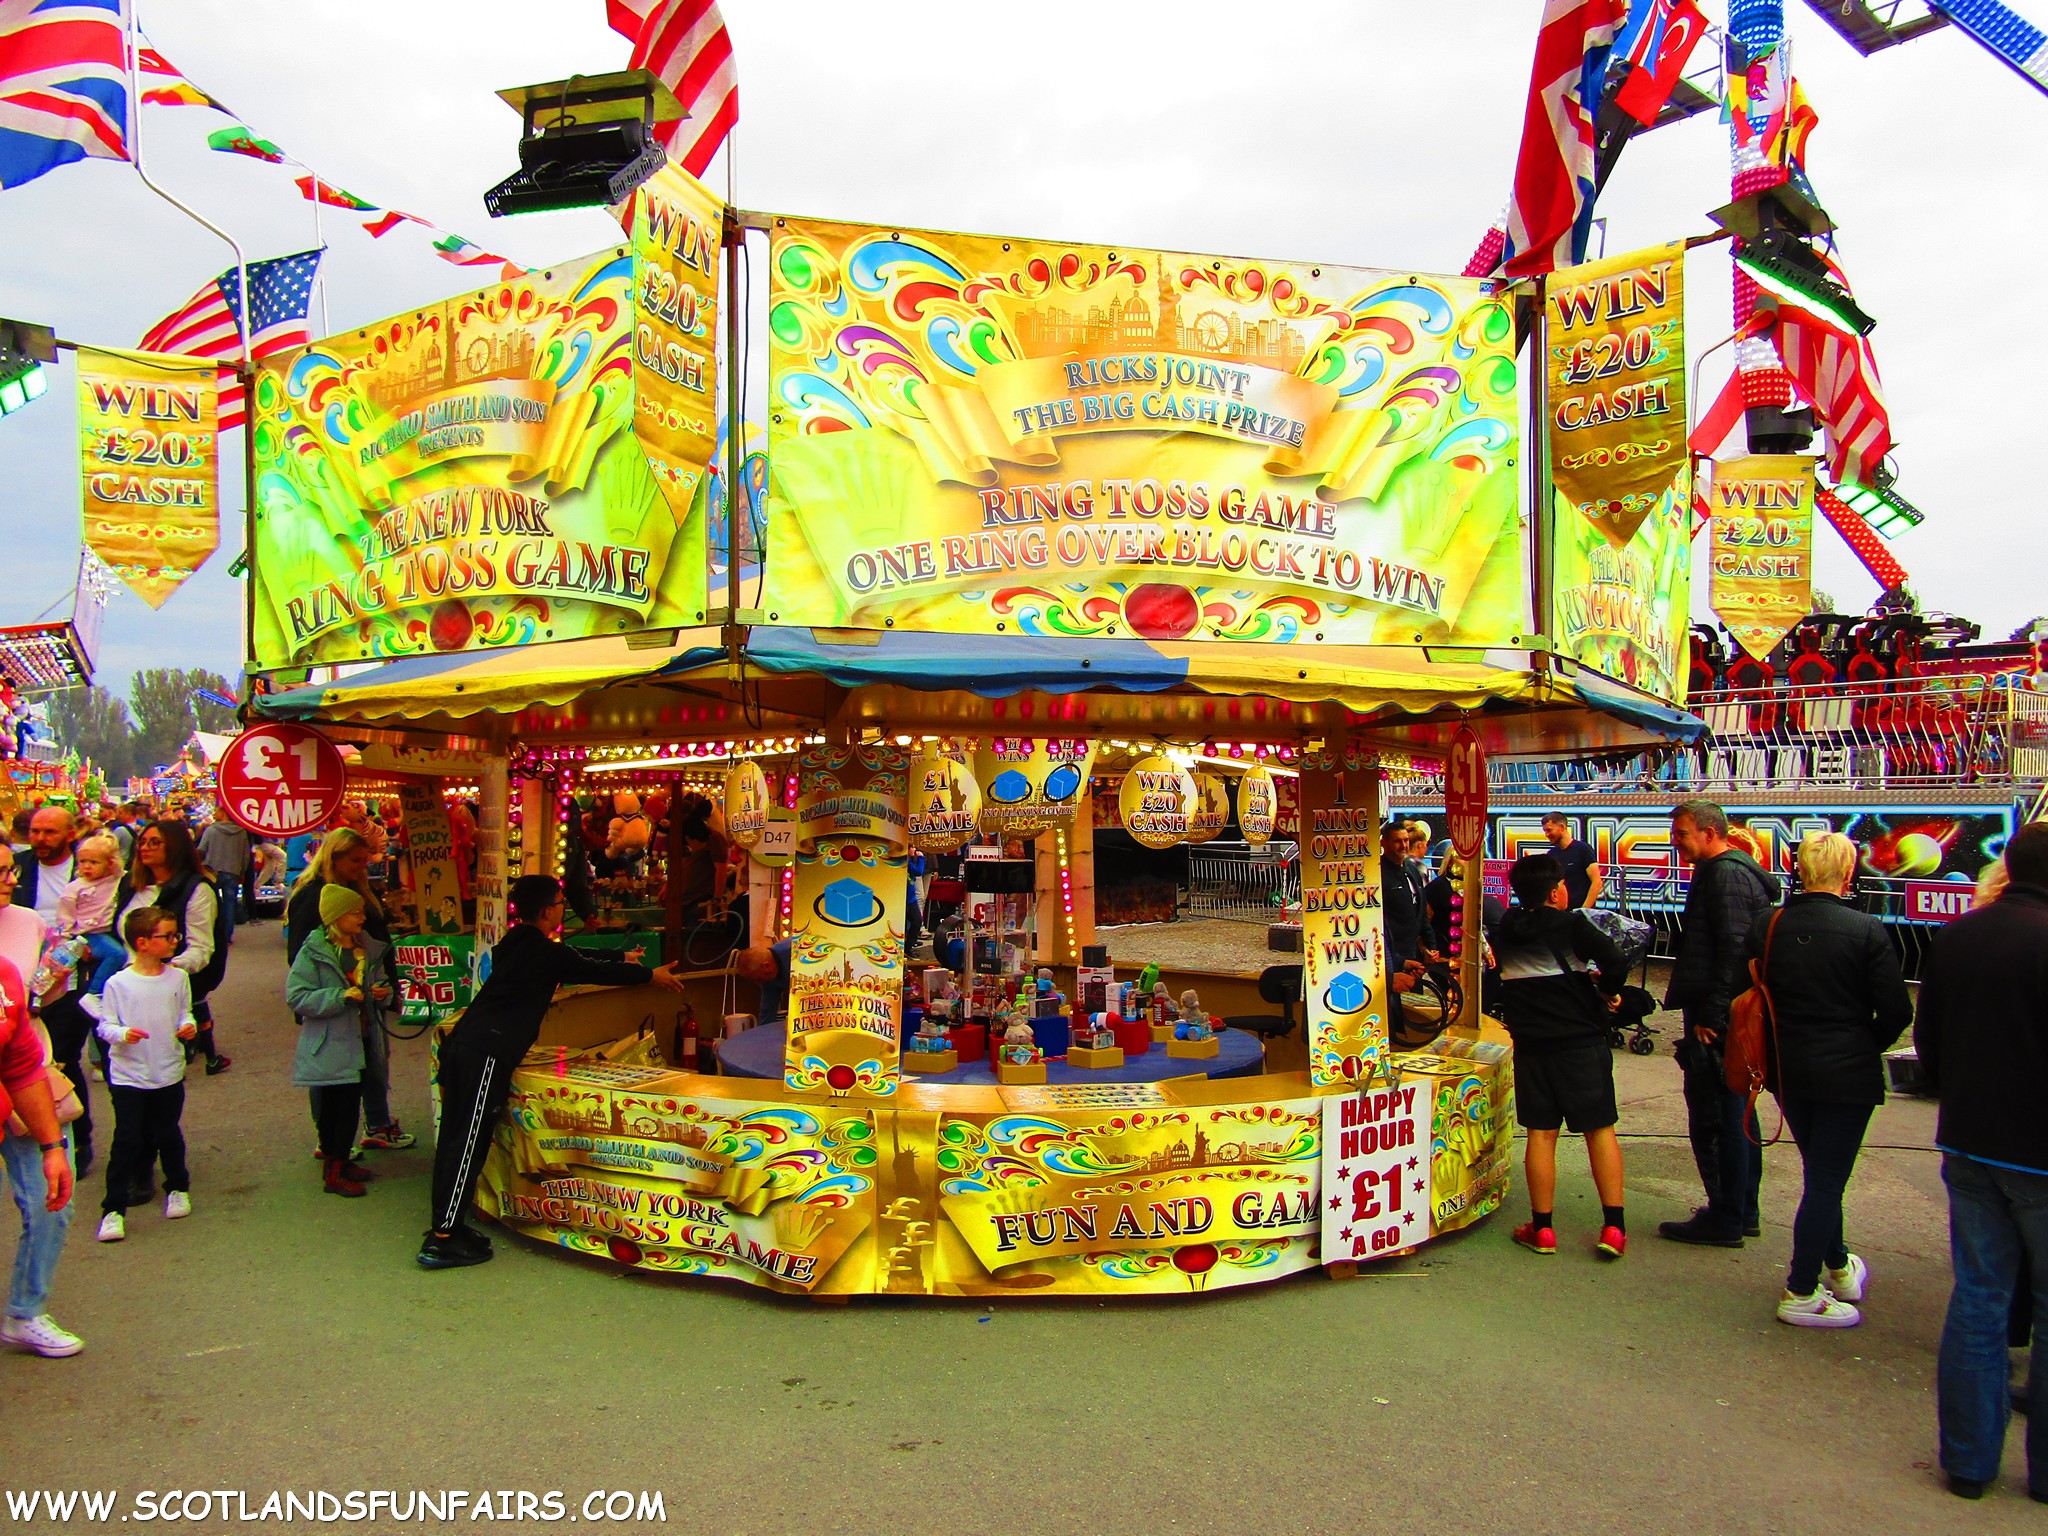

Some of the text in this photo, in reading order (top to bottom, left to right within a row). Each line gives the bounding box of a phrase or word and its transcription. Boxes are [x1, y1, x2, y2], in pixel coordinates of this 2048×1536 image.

[641, 185, 715, 277] WIN
[643, 262, 697, 333] £20
[1549, 260, 1673, 331] WIN
[636, 323, 706, 393] CASH
[1567, 324, 1653, 384] £20
[1064, 354, 1250, 394] RICKS JOINT
[83, 379, 201, 422] WIN
[1555, 378, 1670, 431] CASH
[360, 395, 548, 466] RICHARD SMITH AND SON
[1014, 392, 1306, 447] THE BIG CASH PRIZE
[102, 429, 190, 467] £20
[416, 426, 484, 459] PRESENTS
[90, 473, 205, 507] CASH
[1717, 479, 1806, 509] WIN
[979, 478, 1339, 537] RING TOSS GAME
[360, 484, 553, 563] THE NEW YORK
[1724, 517, 1789, 547] £20
[846, 522, 1446, 614] ONE RING OVER BLOCK TO WIN
[1714, 553, 1799, 579] CASH
[286, 540, 650, 644] RING TOSS GAME
[242, 735, 318, 782] £1
[1450, 742, 1477, 794] £1
[275, 782, 291, 796] A
[741, 772, 753, 792] £1
[923, 769, 948, 791] £1
[1135, 770, 1183, 792] WIN
[1246, 777, 1271, 797] WIN
[1333, 771, 1348, 805] 1
[240, 797, 324, 830] GAME
[743, 795, 752, 812] A
[840, 796, 868, 814] SMITH
[868, 800, 887, 820] AND
[928, 791, 946, 812] A
[983, 808, 1000, 819] NO
[1141, 792, 1178, 812] £20
[1249, 797, 1268, 814] £20
[1462, 796, 1468, 811] A
[731, 809, 765, 832] GAME
[908, 811, 975, 834] GAME
[1128, 812, 1189, 832] CASH
[1242, 814, 1273, 833] CASH
[1313, 808, 1369, 832] RING
[1452, 814, 1480, 851] GAME
[410, 831, 449, 847] CRAZY
[764, 831, 791, 844] D47
[1310, 834, 1371, 859] OVER
[1319, 861, 1366, 885] THE
[477, 879, 503, 900] BLOCK
[1304, 884, 1381, 912] BLOCK
[1917, 891, 1973, 915] EXIT
[483, 902, 495, 921] TO
[1328, 912, 1360, 937] TO
[480, 923, 497, 945] WIN
[395, 945, 454, 966] AUNCH
[1322, 938, 1369, 965] WIN
[799, 992, 892, 1020] THE NEW YORK
[1153, 1003, 1162, 1023] PRIME
[792, 1010, 896, 1040] RING TOSS GAME
[1340, 1087, 1417, 1129] HAPPY
[1340, 1118, 1415, 1160] HOUR
[538, 1137, 723, 1174] RICHARD SMITH AND SON
[542, 1177, 729, 1227] THE NEW YORK
[1351, 1163, 1402, 1223] £1
[1438, 1192, 1466, 1221] ONE
[501, 1189, 818, 1284] RING TOSS GAME
[991, 1204, 1098, 1252] FUN
[1109, 1196, 1214, 1240] AND
[1351, 1225, 1400, 1258] A GO
